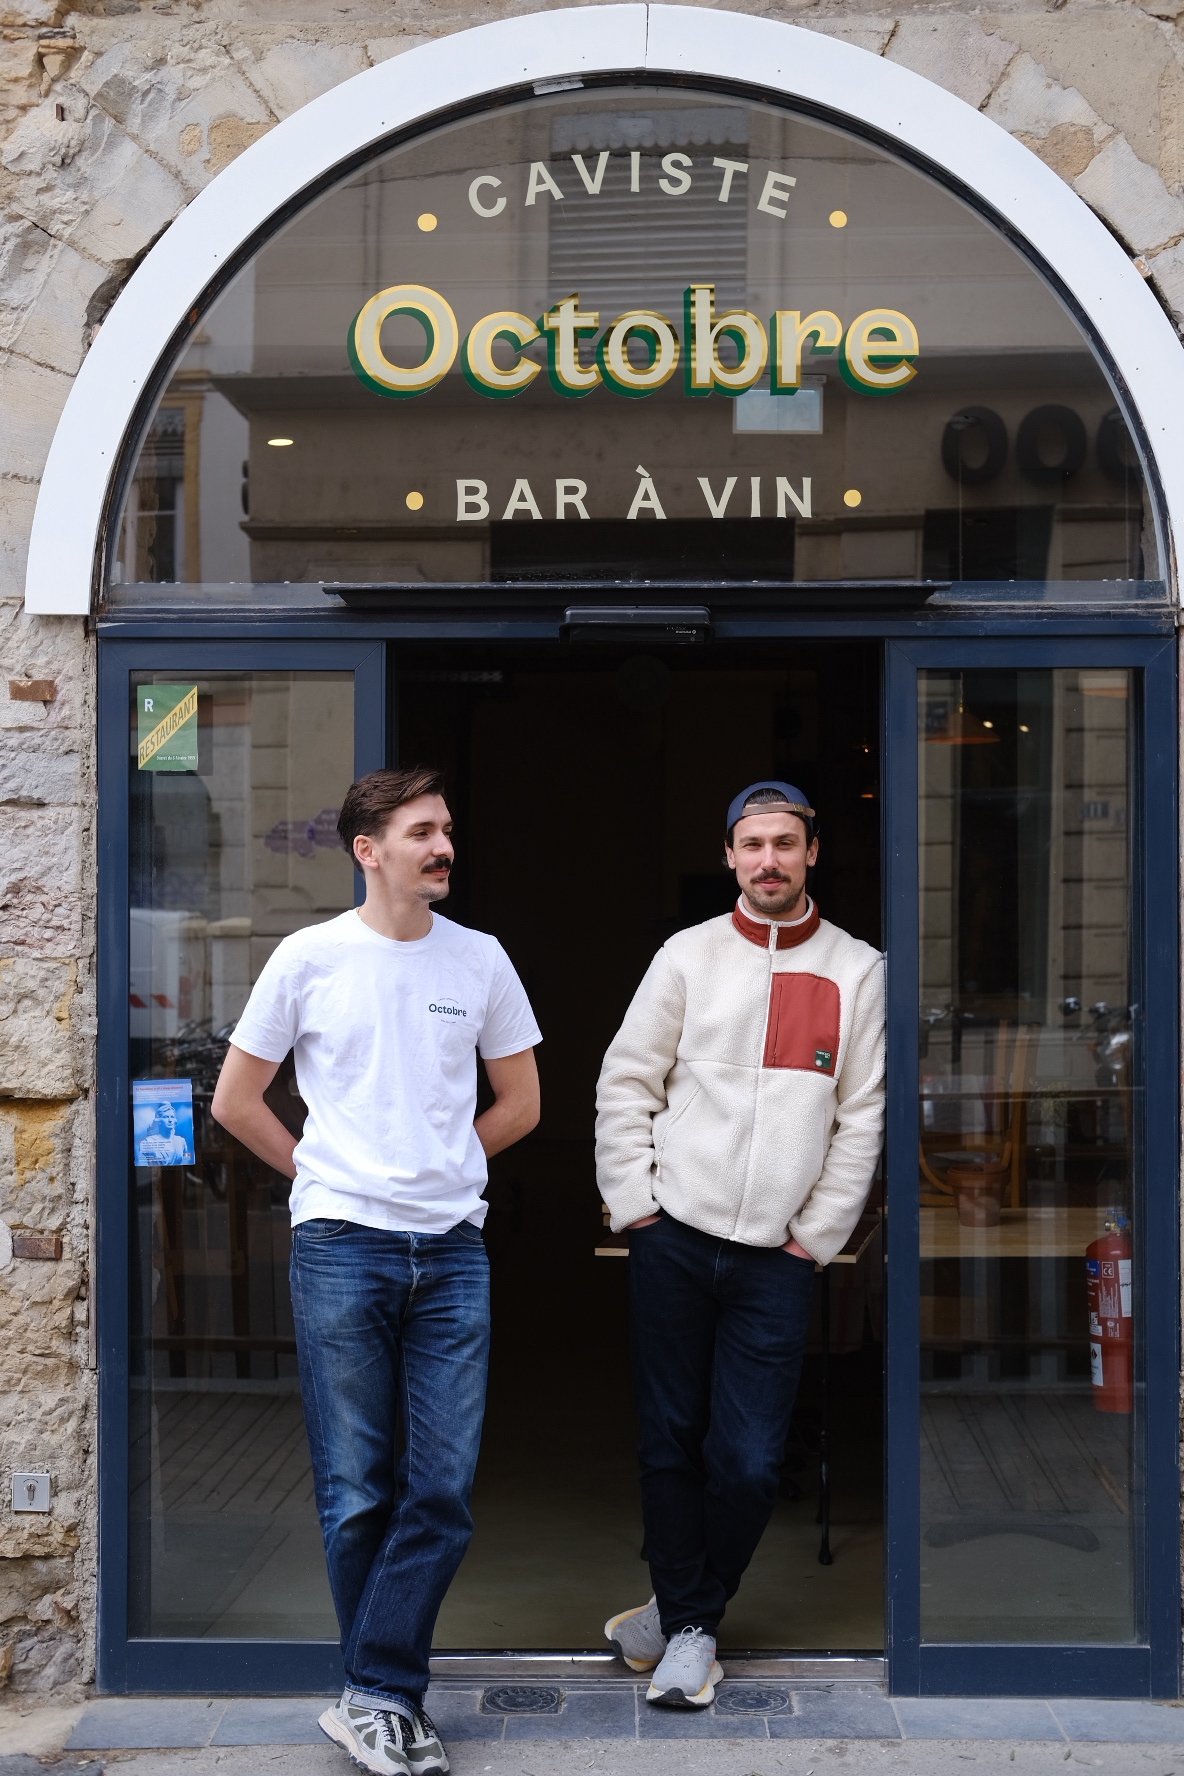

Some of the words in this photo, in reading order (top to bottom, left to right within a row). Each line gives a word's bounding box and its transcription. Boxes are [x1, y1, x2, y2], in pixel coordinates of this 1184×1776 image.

[468, 151, 797, 219] CAVISTE
[347, 284, 919, 399] Octobre
[456, 478, 591, 521] BAR
[627, 465, 666, 519] À
[697, 477, 812, 518] VIN
[139, 692, 196, 764] RESTAURANT
[144, 698, 154, 712] R
[428, 1003, 467, 1017] Octobre
